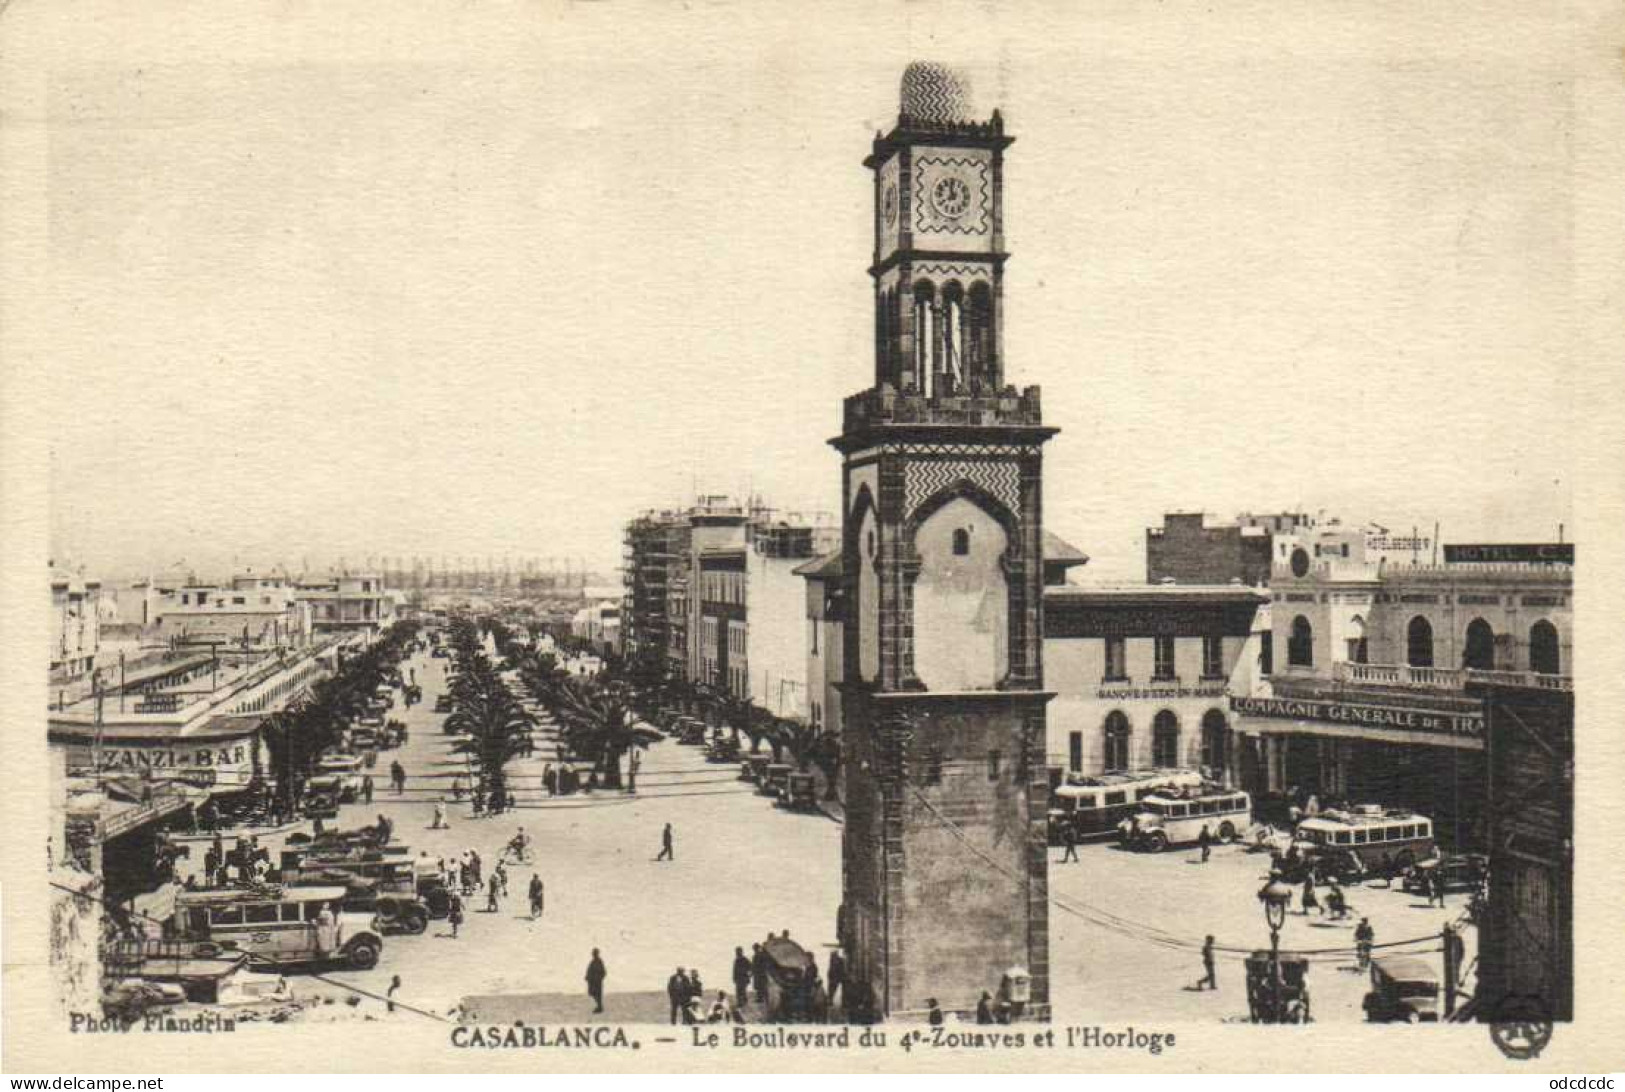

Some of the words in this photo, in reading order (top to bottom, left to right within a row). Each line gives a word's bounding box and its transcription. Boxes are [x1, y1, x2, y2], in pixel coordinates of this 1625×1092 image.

[1234, 698, 1321, 718] COMPAGNIE
[1328, 705, 1415, 728] GENERALE
[1423, 717, 1441, 729] DE
